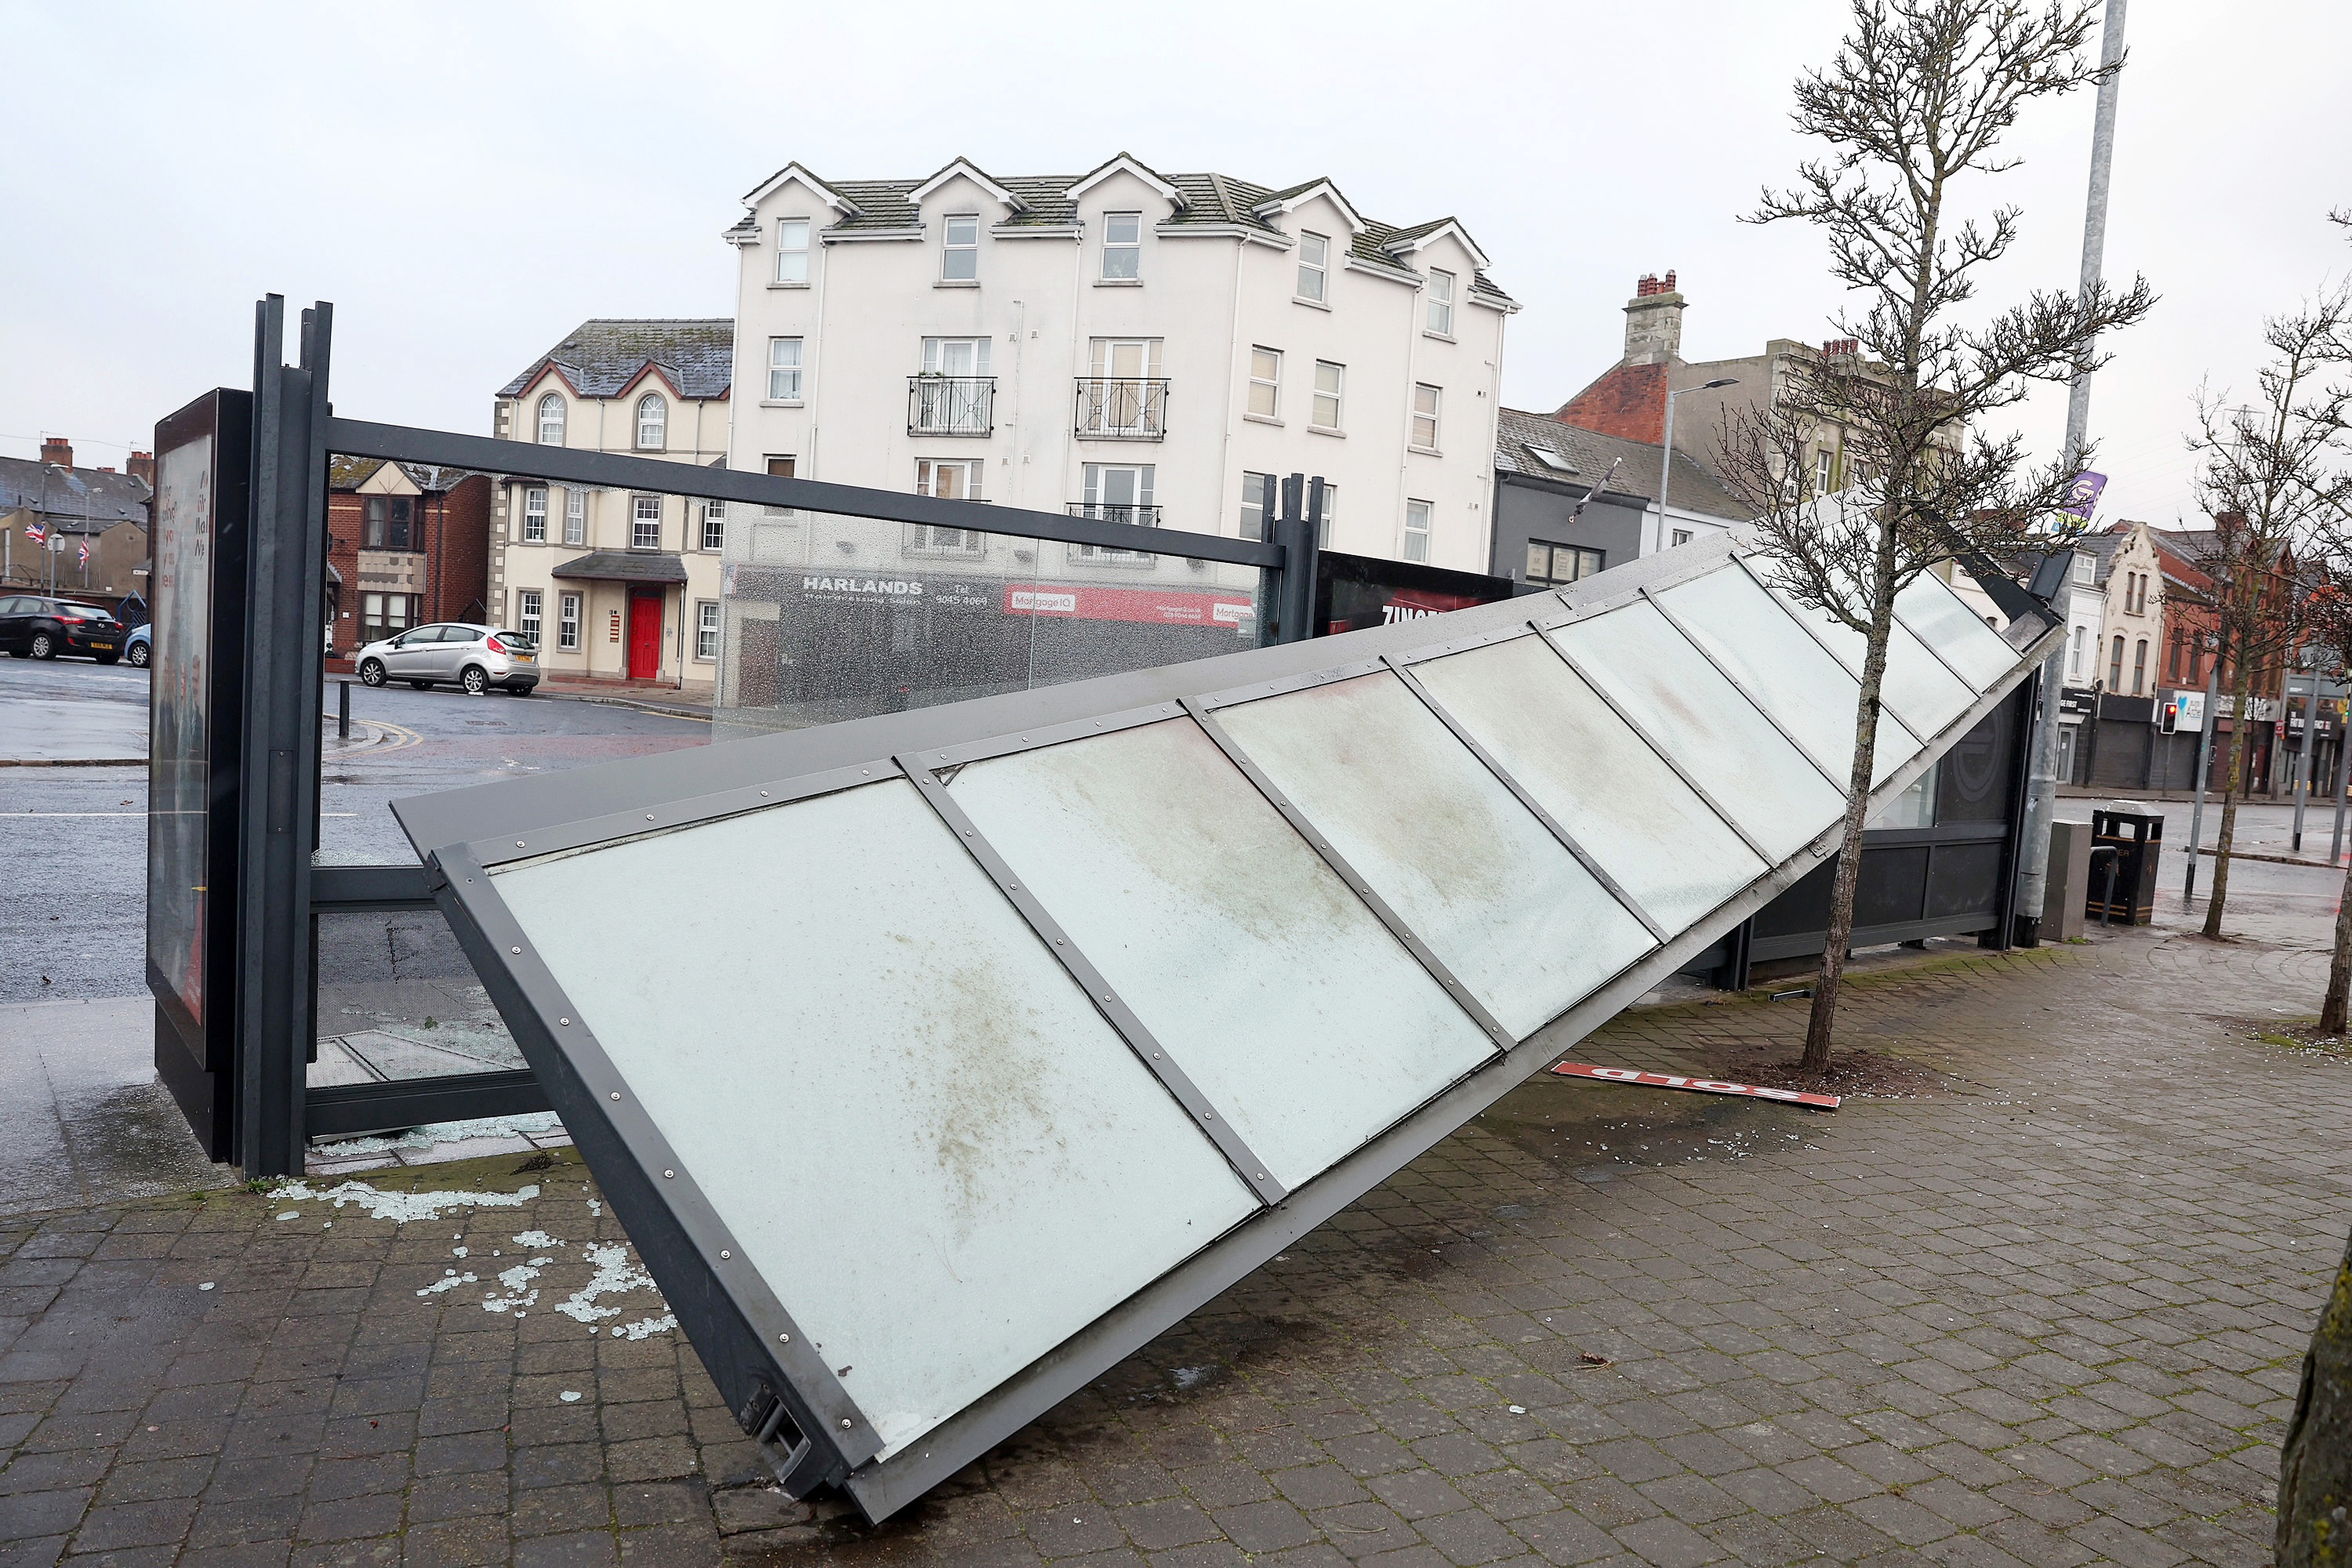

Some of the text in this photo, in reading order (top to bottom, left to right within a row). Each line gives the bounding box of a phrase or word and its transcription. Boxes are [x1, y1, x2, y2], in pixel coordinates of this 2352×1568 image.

[804, 577, 923, 595] HARLANDS
[1015, 597, 1058, 608] Morgage
[1591, 1068, 1802, 1099] SOLD
